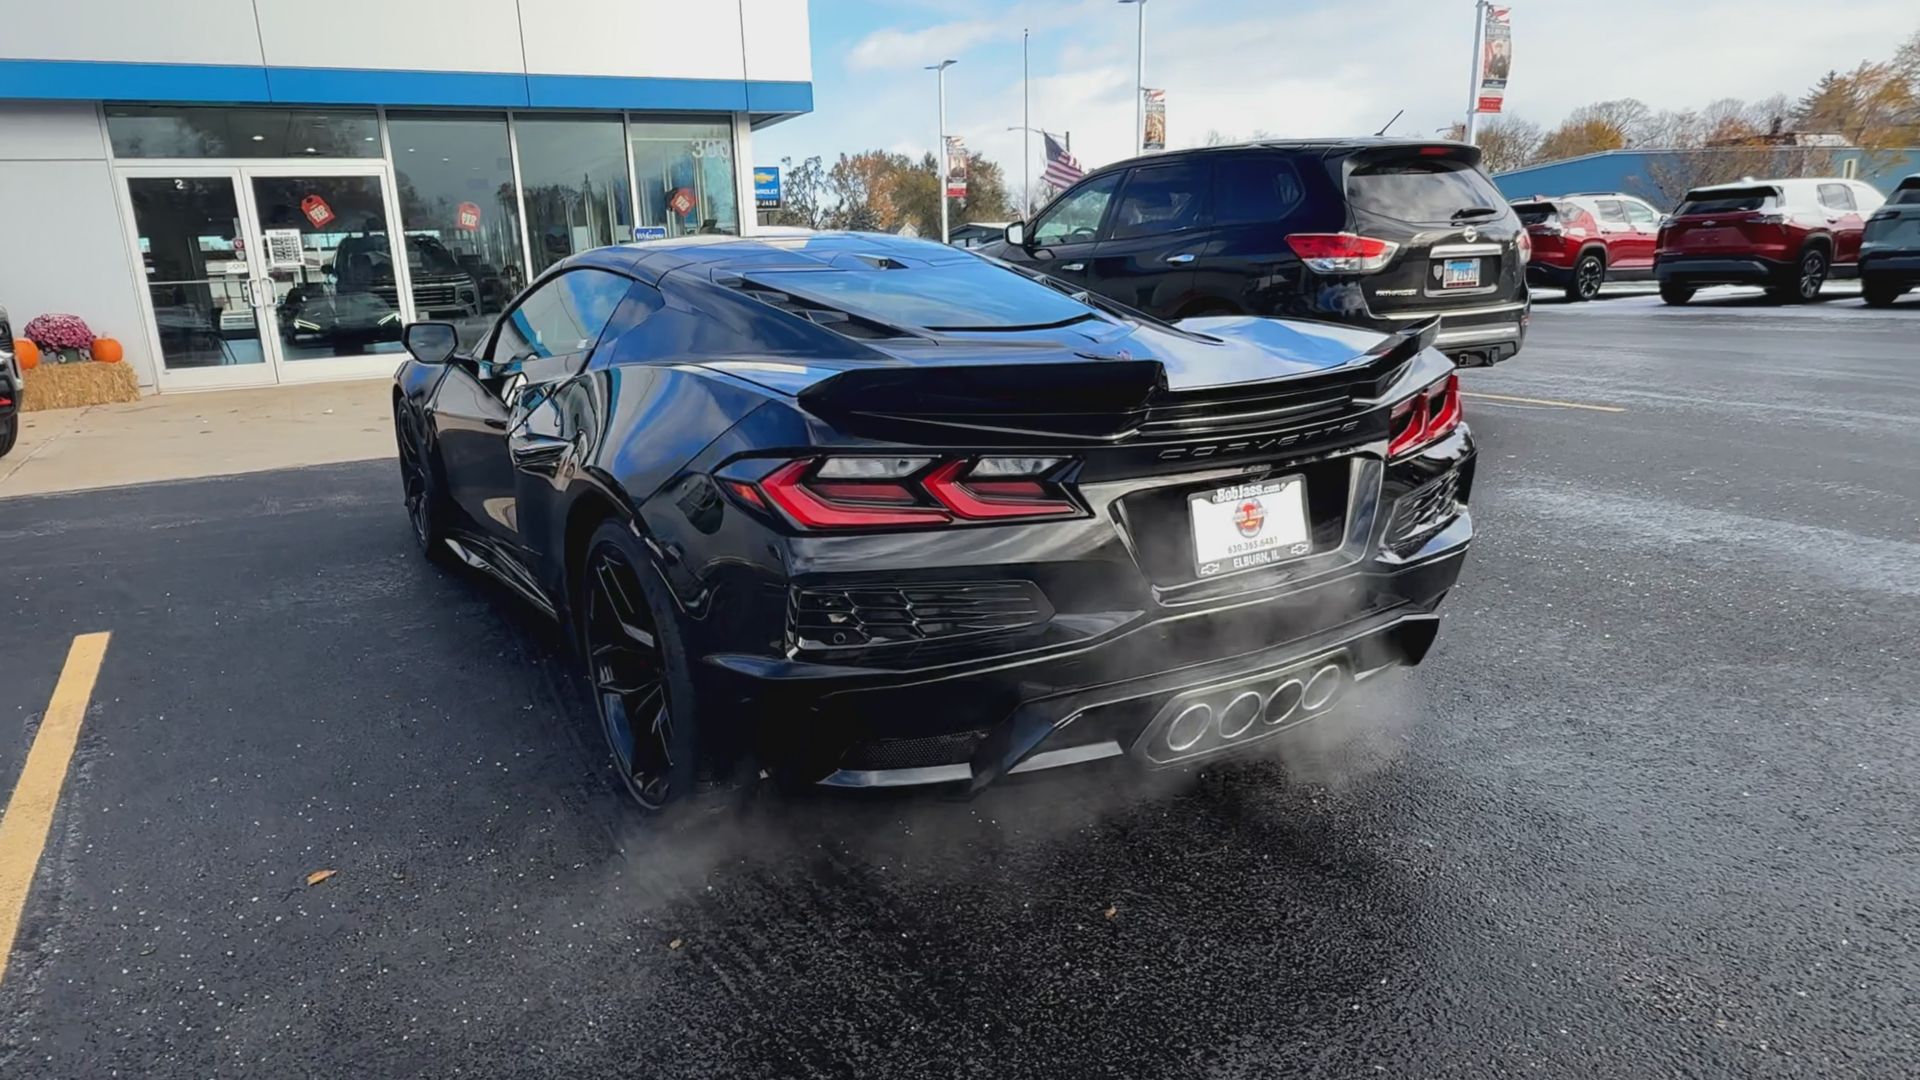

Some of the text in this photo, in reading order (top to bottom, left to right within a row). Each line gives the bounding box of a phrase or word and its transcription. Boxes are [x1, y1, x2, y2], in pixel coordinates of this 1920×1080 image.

[174, 179, 184, 190] 2
[1158, 420, 1360, 459] CORVETTE
[1215, 484, 1281, 501] BobJass.com
[1233, 549, 1280, 568] ELBURN, IL
